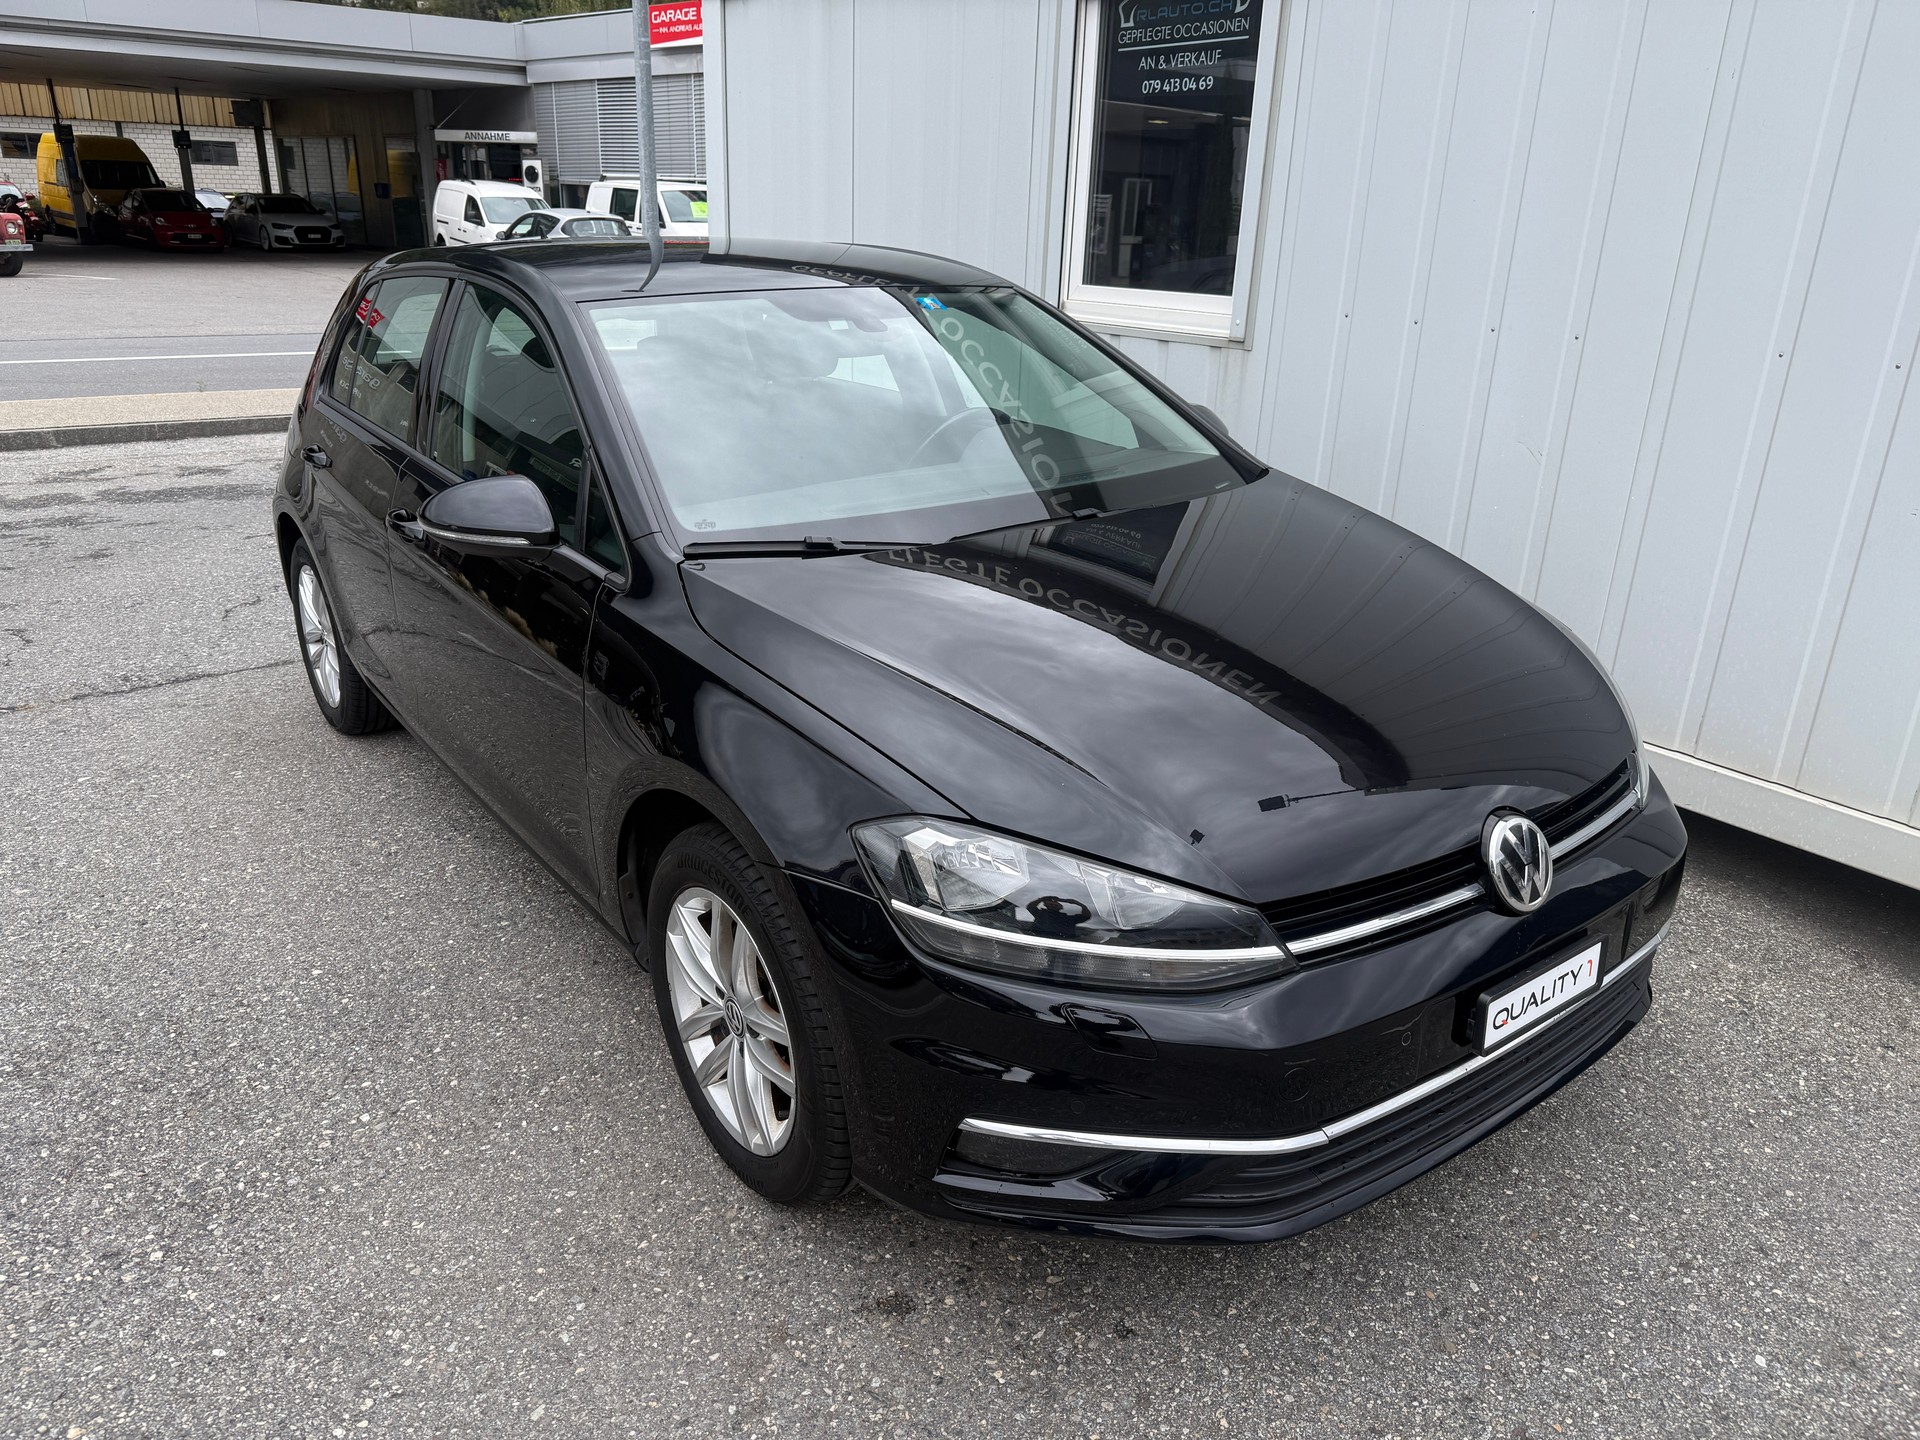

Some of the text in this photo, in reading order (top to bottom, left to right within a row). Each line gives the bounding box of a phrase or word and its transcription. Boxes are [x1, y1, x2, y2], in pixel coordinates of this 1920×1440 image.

[651, 7, 698, 24] GARAGE
[1117, 17, 1250, 44] GEPFLEGTE OCCASIONEN
[1138, 49, 1223, 71] AN & VERKAUF
[1141, 76, 1214, 94] 079 413 04 69
[464, 131, 511, 141] ANNAHME
[677, 852, 754, 921] BRIDGESTONE
[1492, 959, 1594, 1031] QUALITY 1
